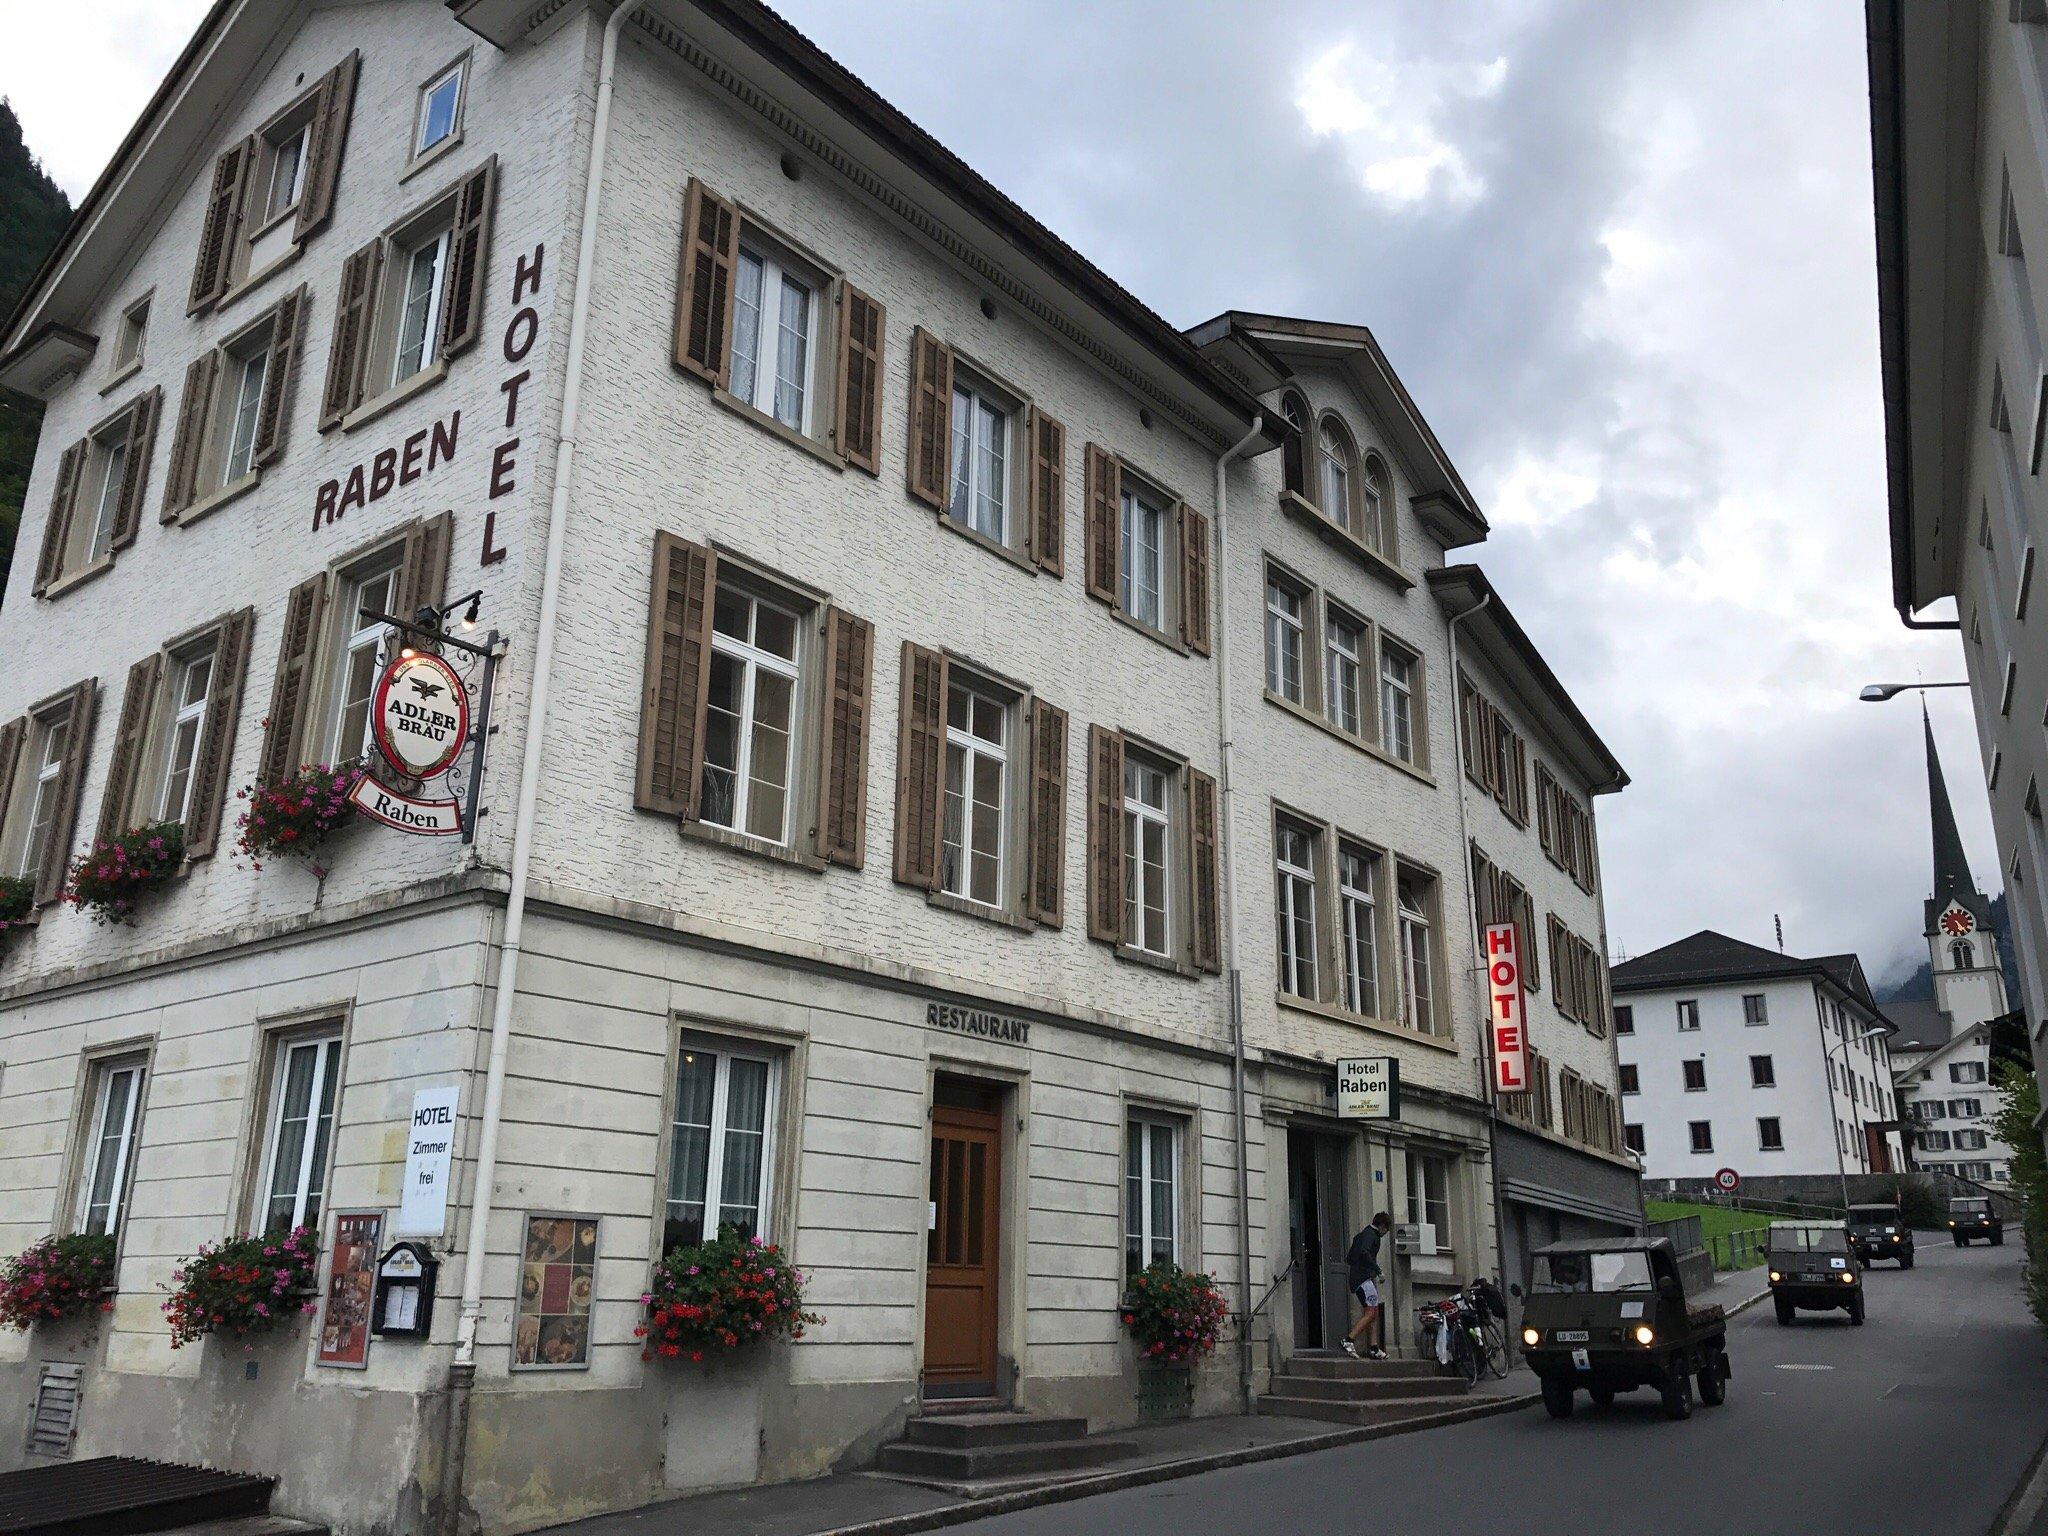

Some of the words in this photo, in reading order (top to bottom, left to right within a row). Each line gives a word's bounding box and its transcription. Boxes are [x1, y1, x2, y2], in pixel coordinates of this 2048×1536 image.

[481, 243, 543, 567] HOTEL
[312, 410, 461, 531] RABEN
[388, 700, 456, 731] ADLER
[397, 718, 446, 742] BRÄU
[373, 792, 440, 828] Raben
[1489, 929, 1521, 1086] HOTEL
[926, 1003, 1030, 1043] RESTAURANT
[1347, 1062, 1379, 1075] Hotel
[1340, 1078, 1387, 1093] Raben
[413, 1106, 453, 1127] HOTEL
[412, 1141, 448, 1155] Zimmer
[419, 1170, 434, 1185] frei
[1722, 1175, 1733, 1184] 40
